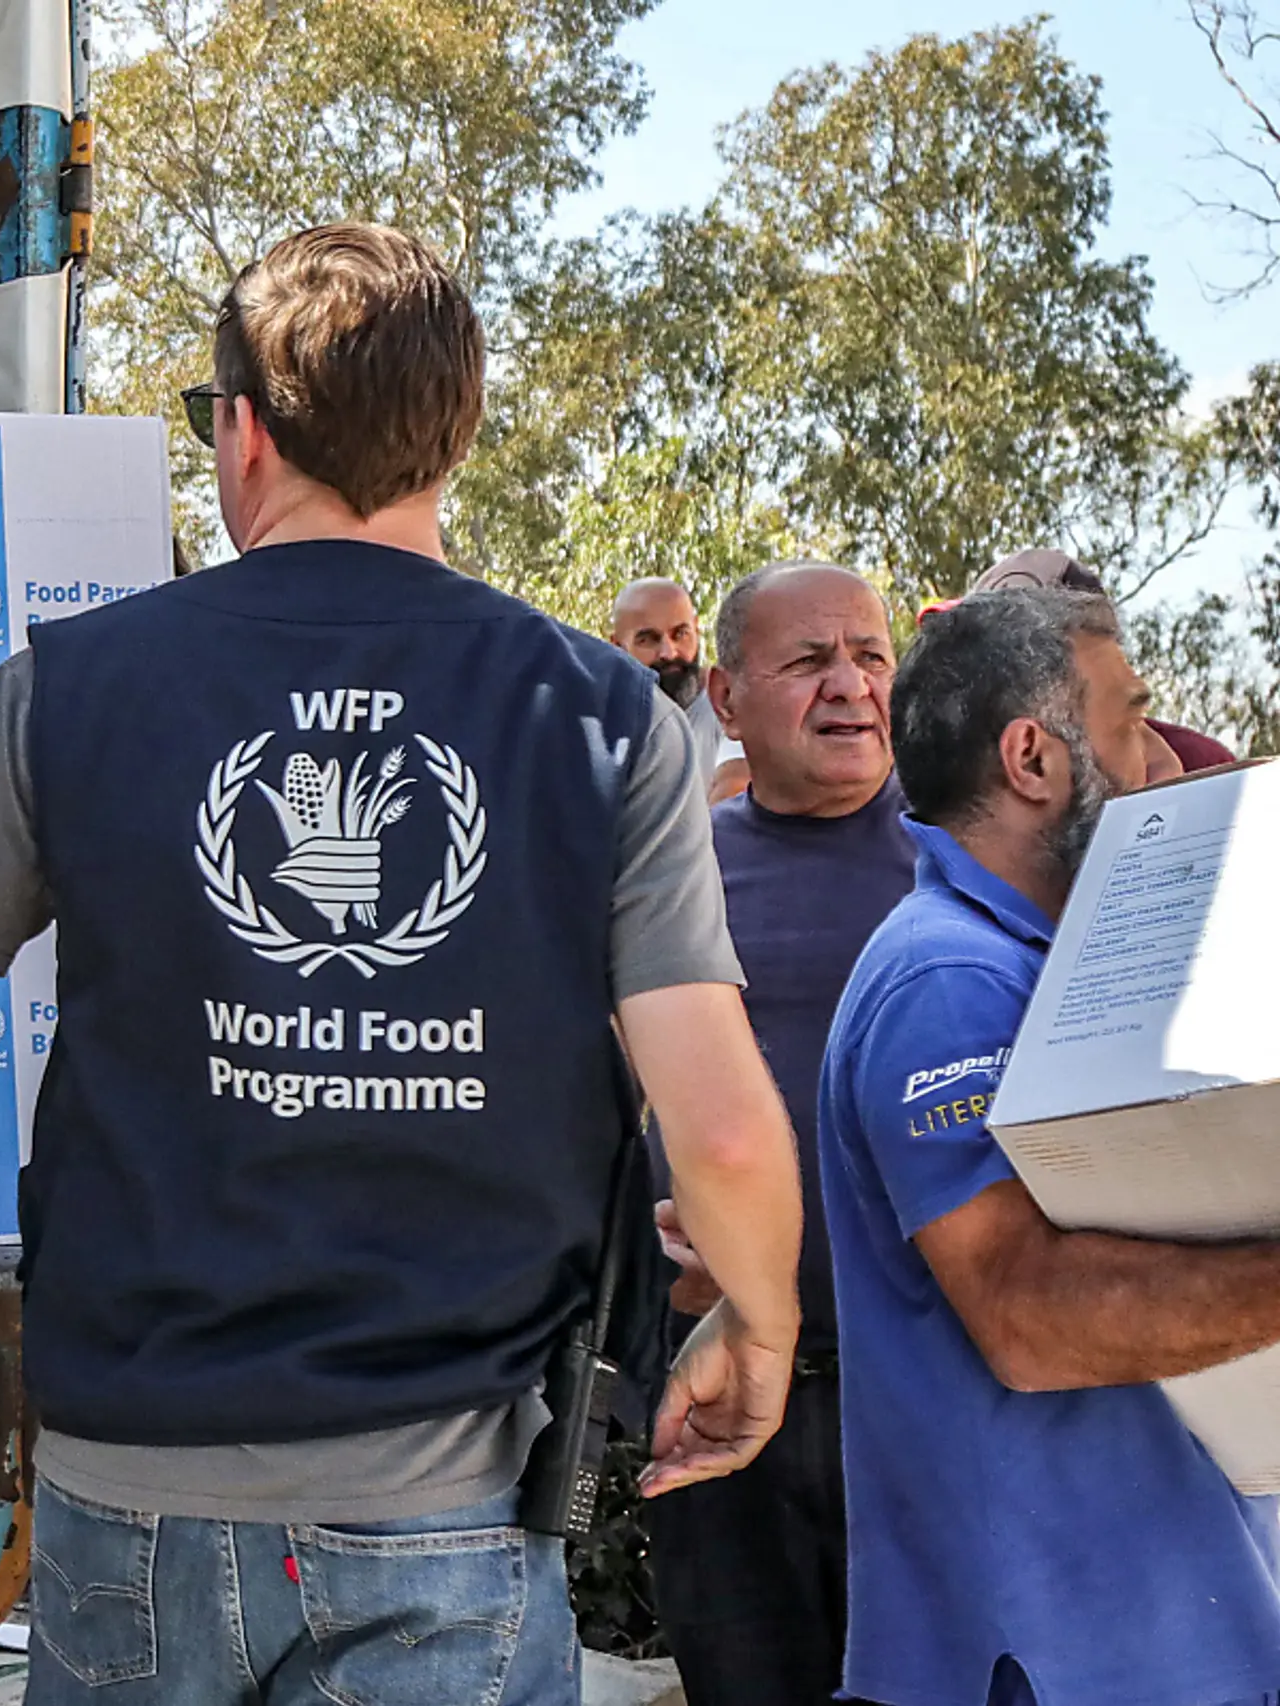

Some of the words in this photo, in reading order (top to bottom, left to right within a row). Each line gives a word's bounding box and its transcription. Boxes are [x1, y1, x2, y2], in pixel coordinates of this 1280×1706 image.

[25, 581, 81, 602] Food
[290, 689, 404, 732] WFP
[30, 1001, 58, 1022] Fo
[204, 999, 345, 1051] World
[359, 1009, 485, 1053] Food
[208, 1056, 486, 1118] Programme
